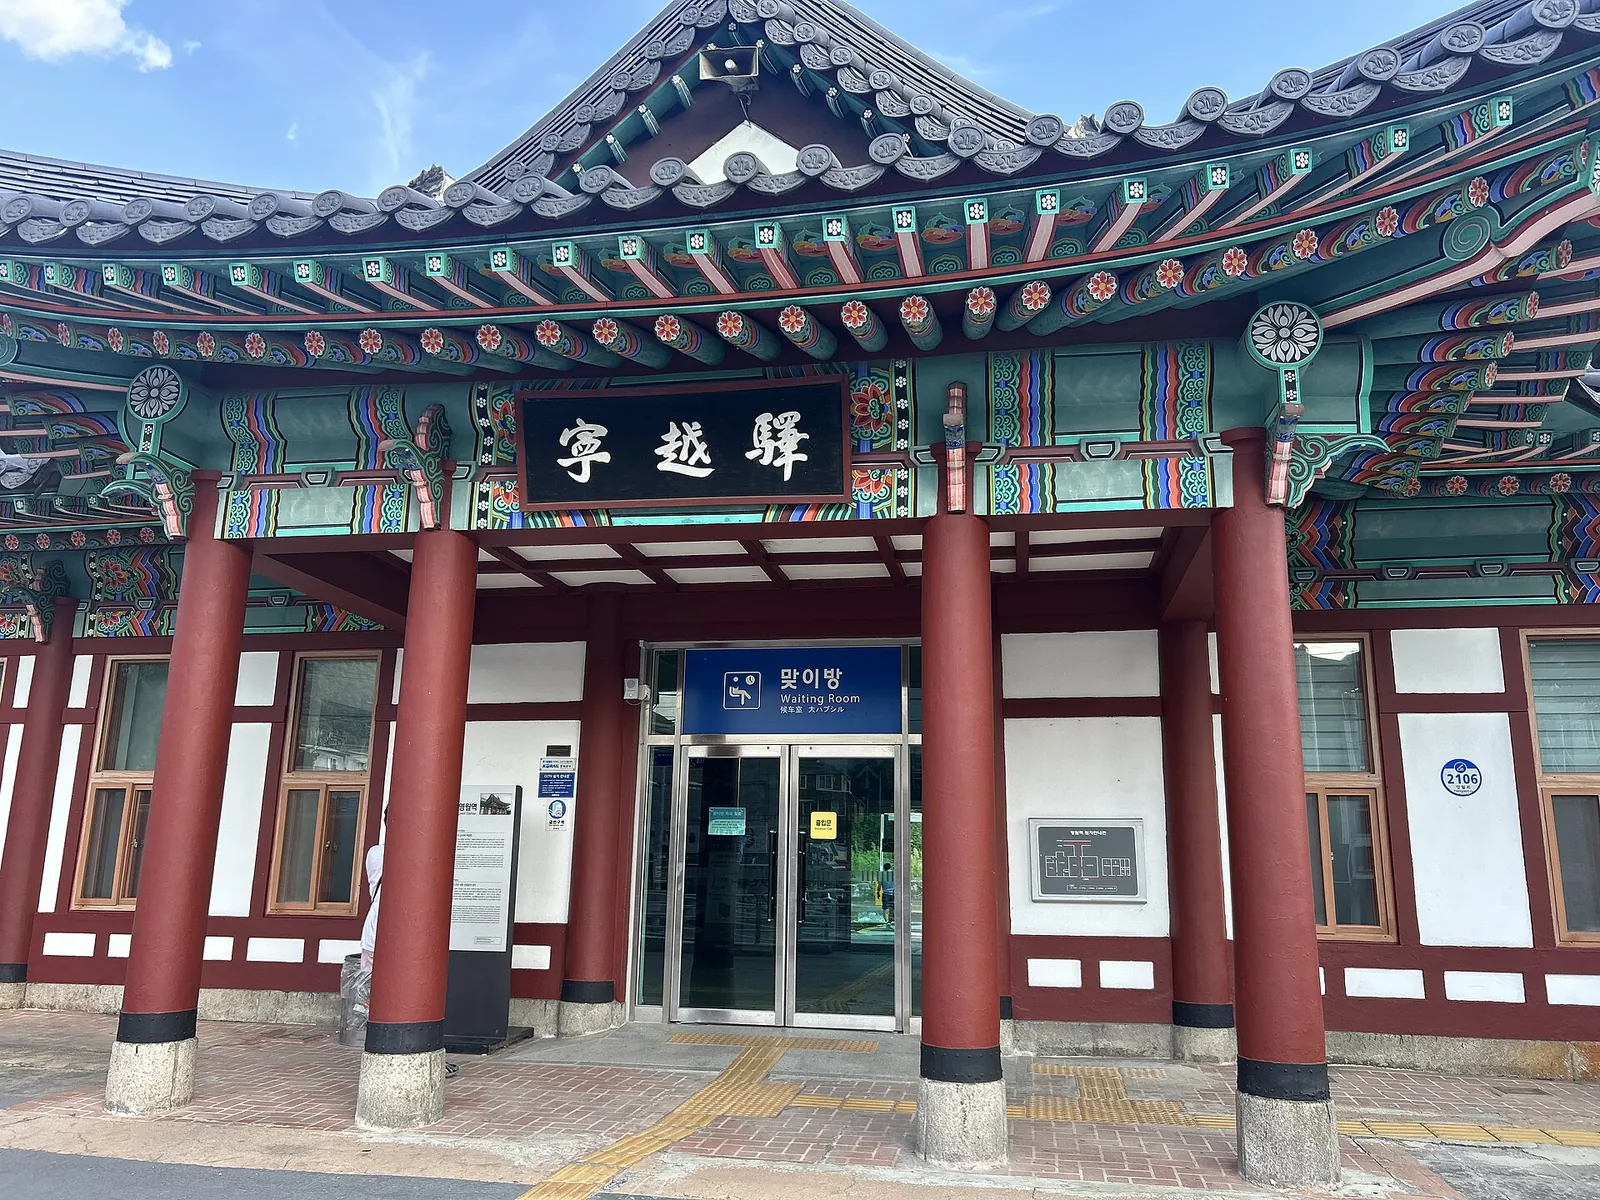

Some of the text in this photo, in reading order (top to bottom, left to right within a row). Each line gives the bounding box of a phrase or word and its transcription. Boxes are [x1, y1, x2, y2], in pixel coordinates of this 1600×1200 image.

[780, 668, 843, 690] 맞이방
[780, 693, 860, 706] Waiting Room
[1447, 773, 1478, 784] 2106
